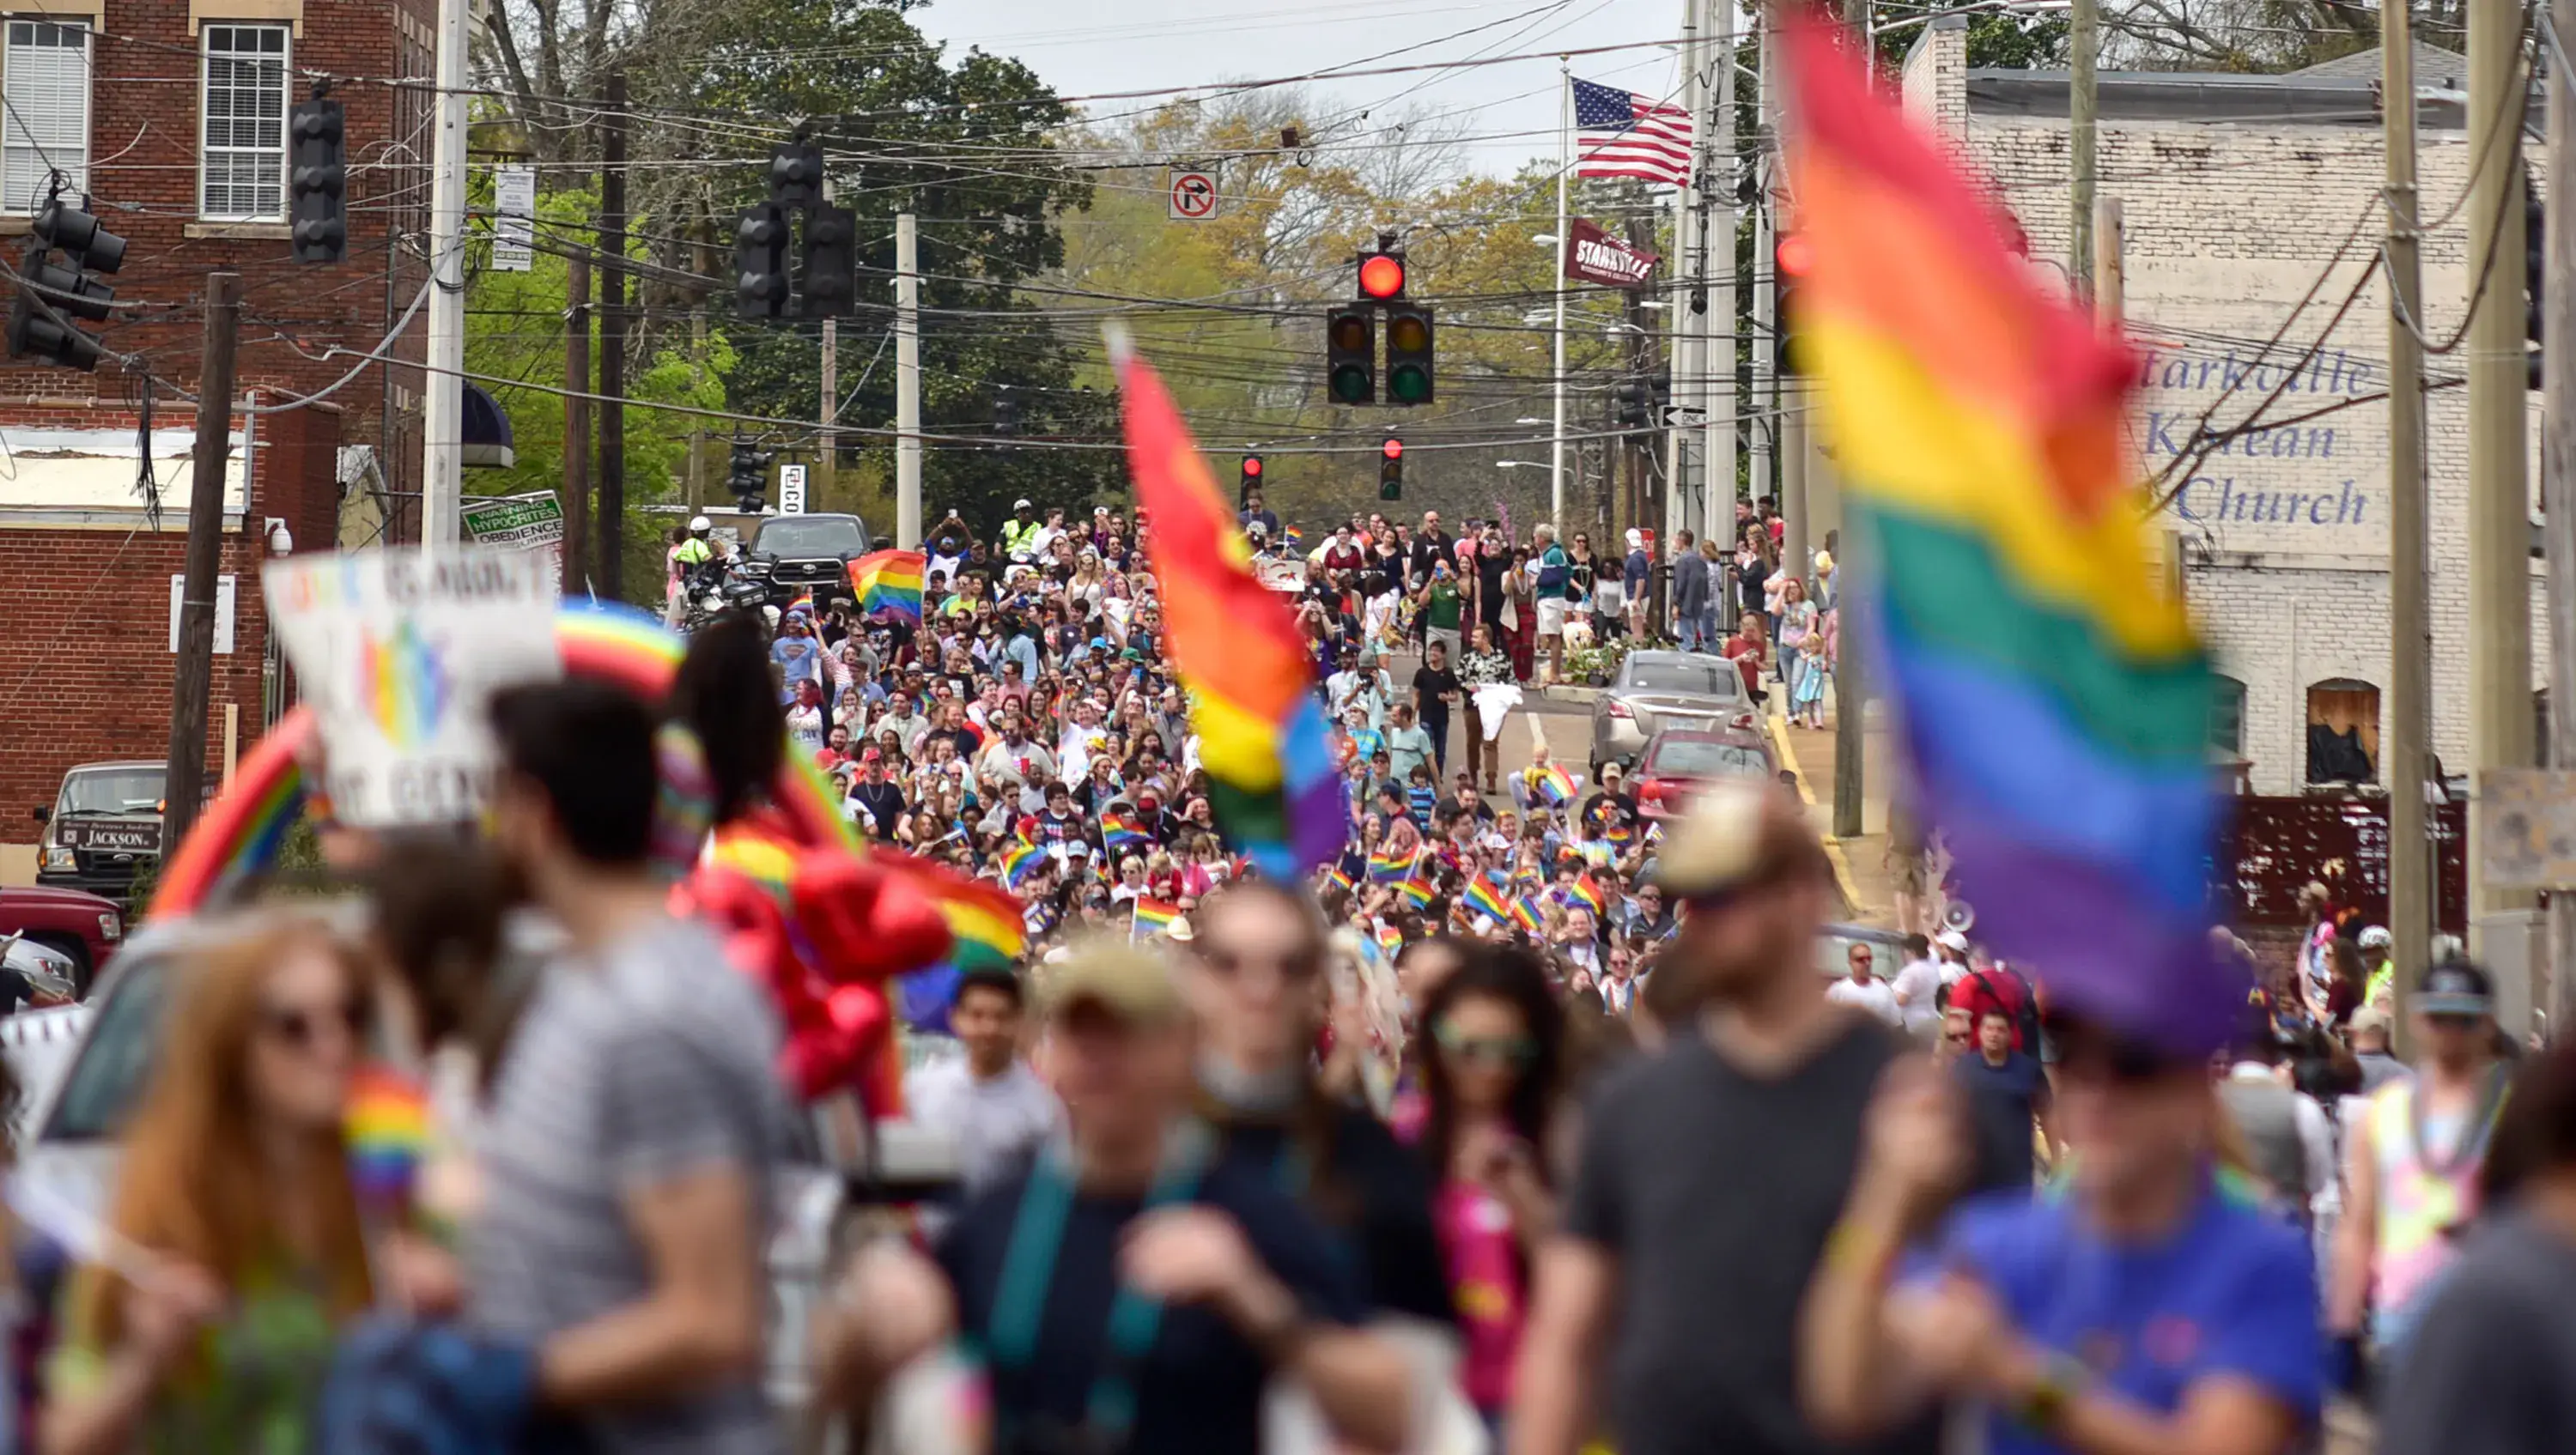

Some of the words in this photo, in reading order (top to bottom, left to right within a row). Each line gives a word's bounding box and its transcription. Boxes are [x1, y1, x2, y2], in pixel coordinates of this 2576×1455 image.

[2138, 349, 2372, 395] tarkville
[477, 500, 547, 519] WARNING
[2177, 476, 2369, 525] Church
[473, 508, 557, 531] HYPOCRITES
[479, 520, 563, 544] OBEDIENCE
[86, 829, 143, 846] JACKSON
